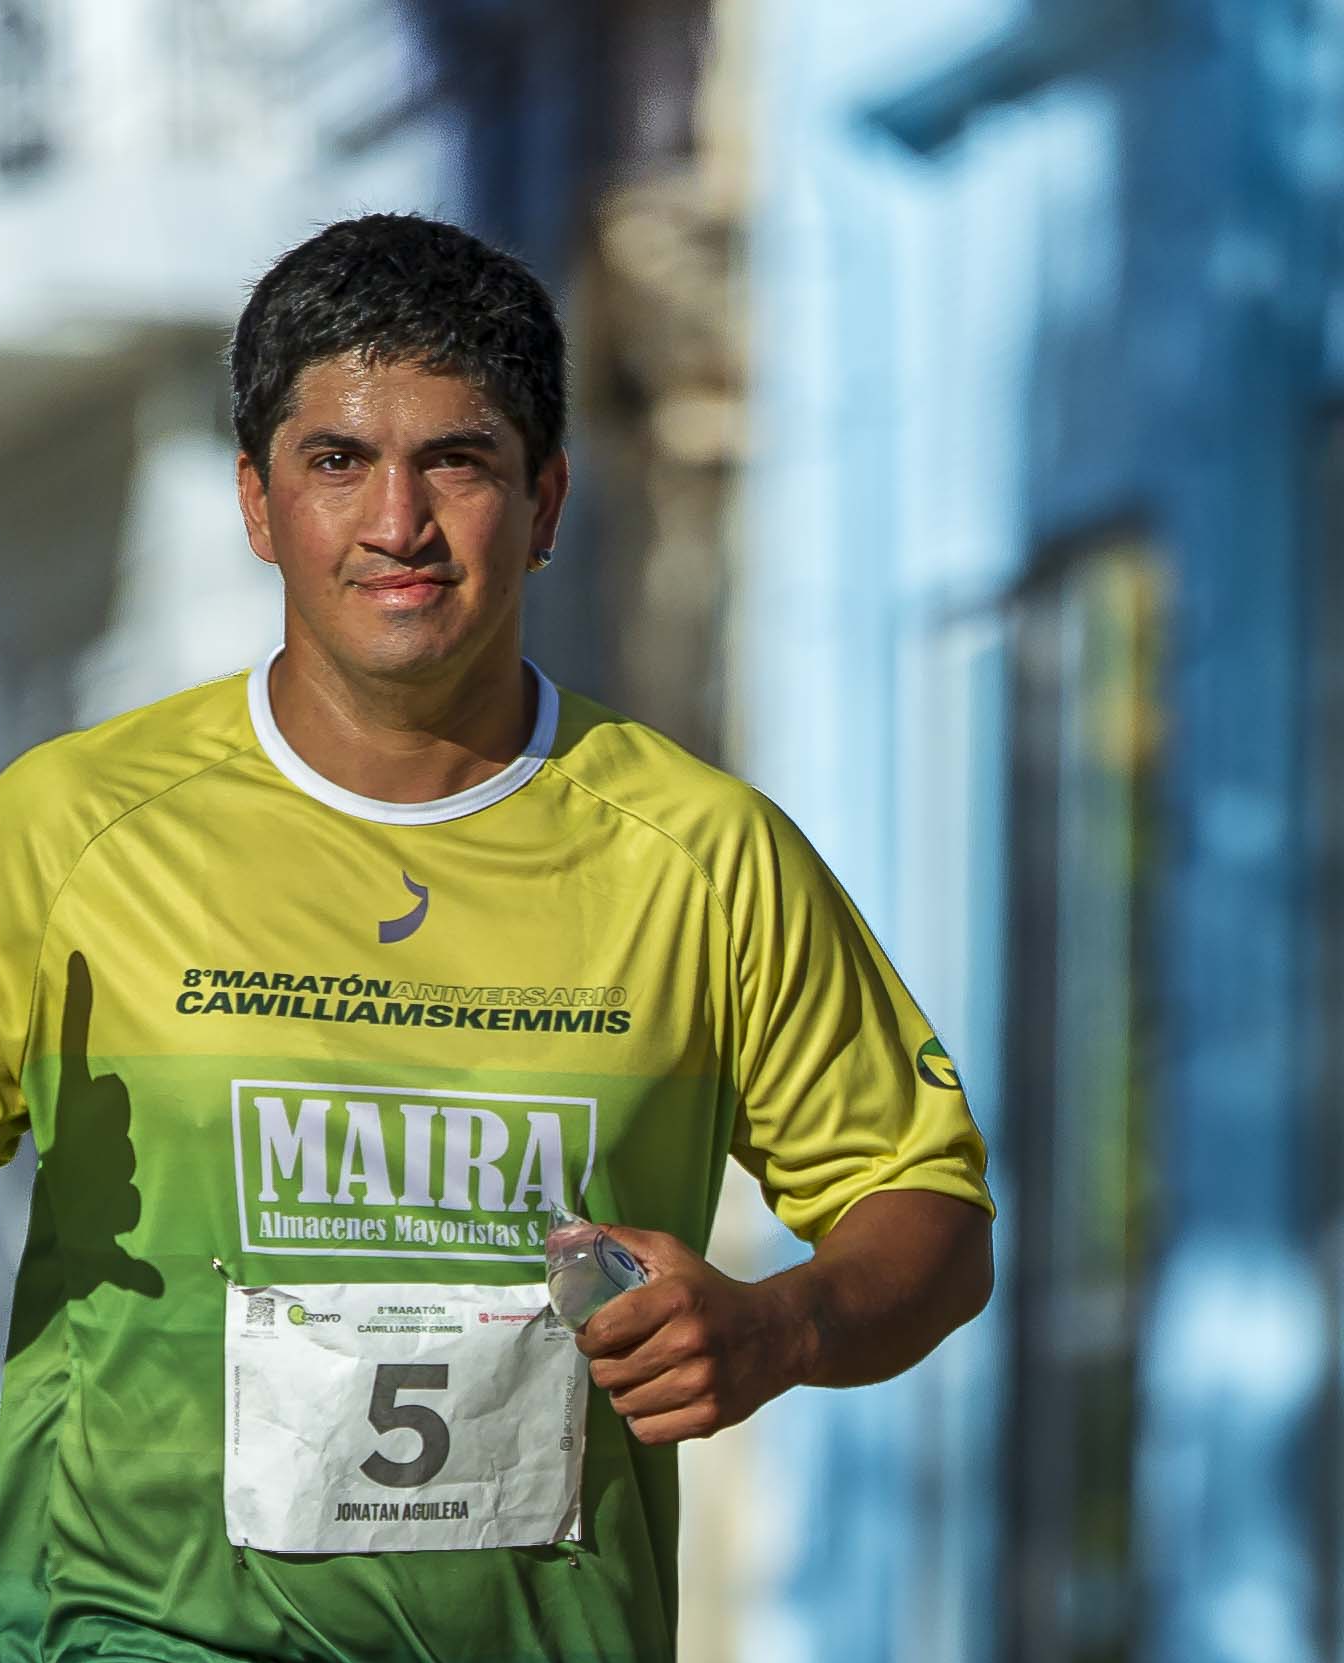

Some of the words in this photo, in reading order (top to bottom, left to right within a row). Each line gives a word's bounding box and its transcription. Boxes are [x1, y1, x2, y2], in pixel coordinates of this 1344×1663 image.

[175, 991, 631, 1034] CAWILLIAMSKEMMIS
[254, 1096, 568, 1213] MAIRA
[259, 1211, 386, 1241] Almacenes
[395, 1215, 519, 1247] Mayoristas
[359, 1363, 451, 1489] 5
[334, 1503, 399, 1521] JONATAN
[402, 1501, 469, 1521] AGUILERA
